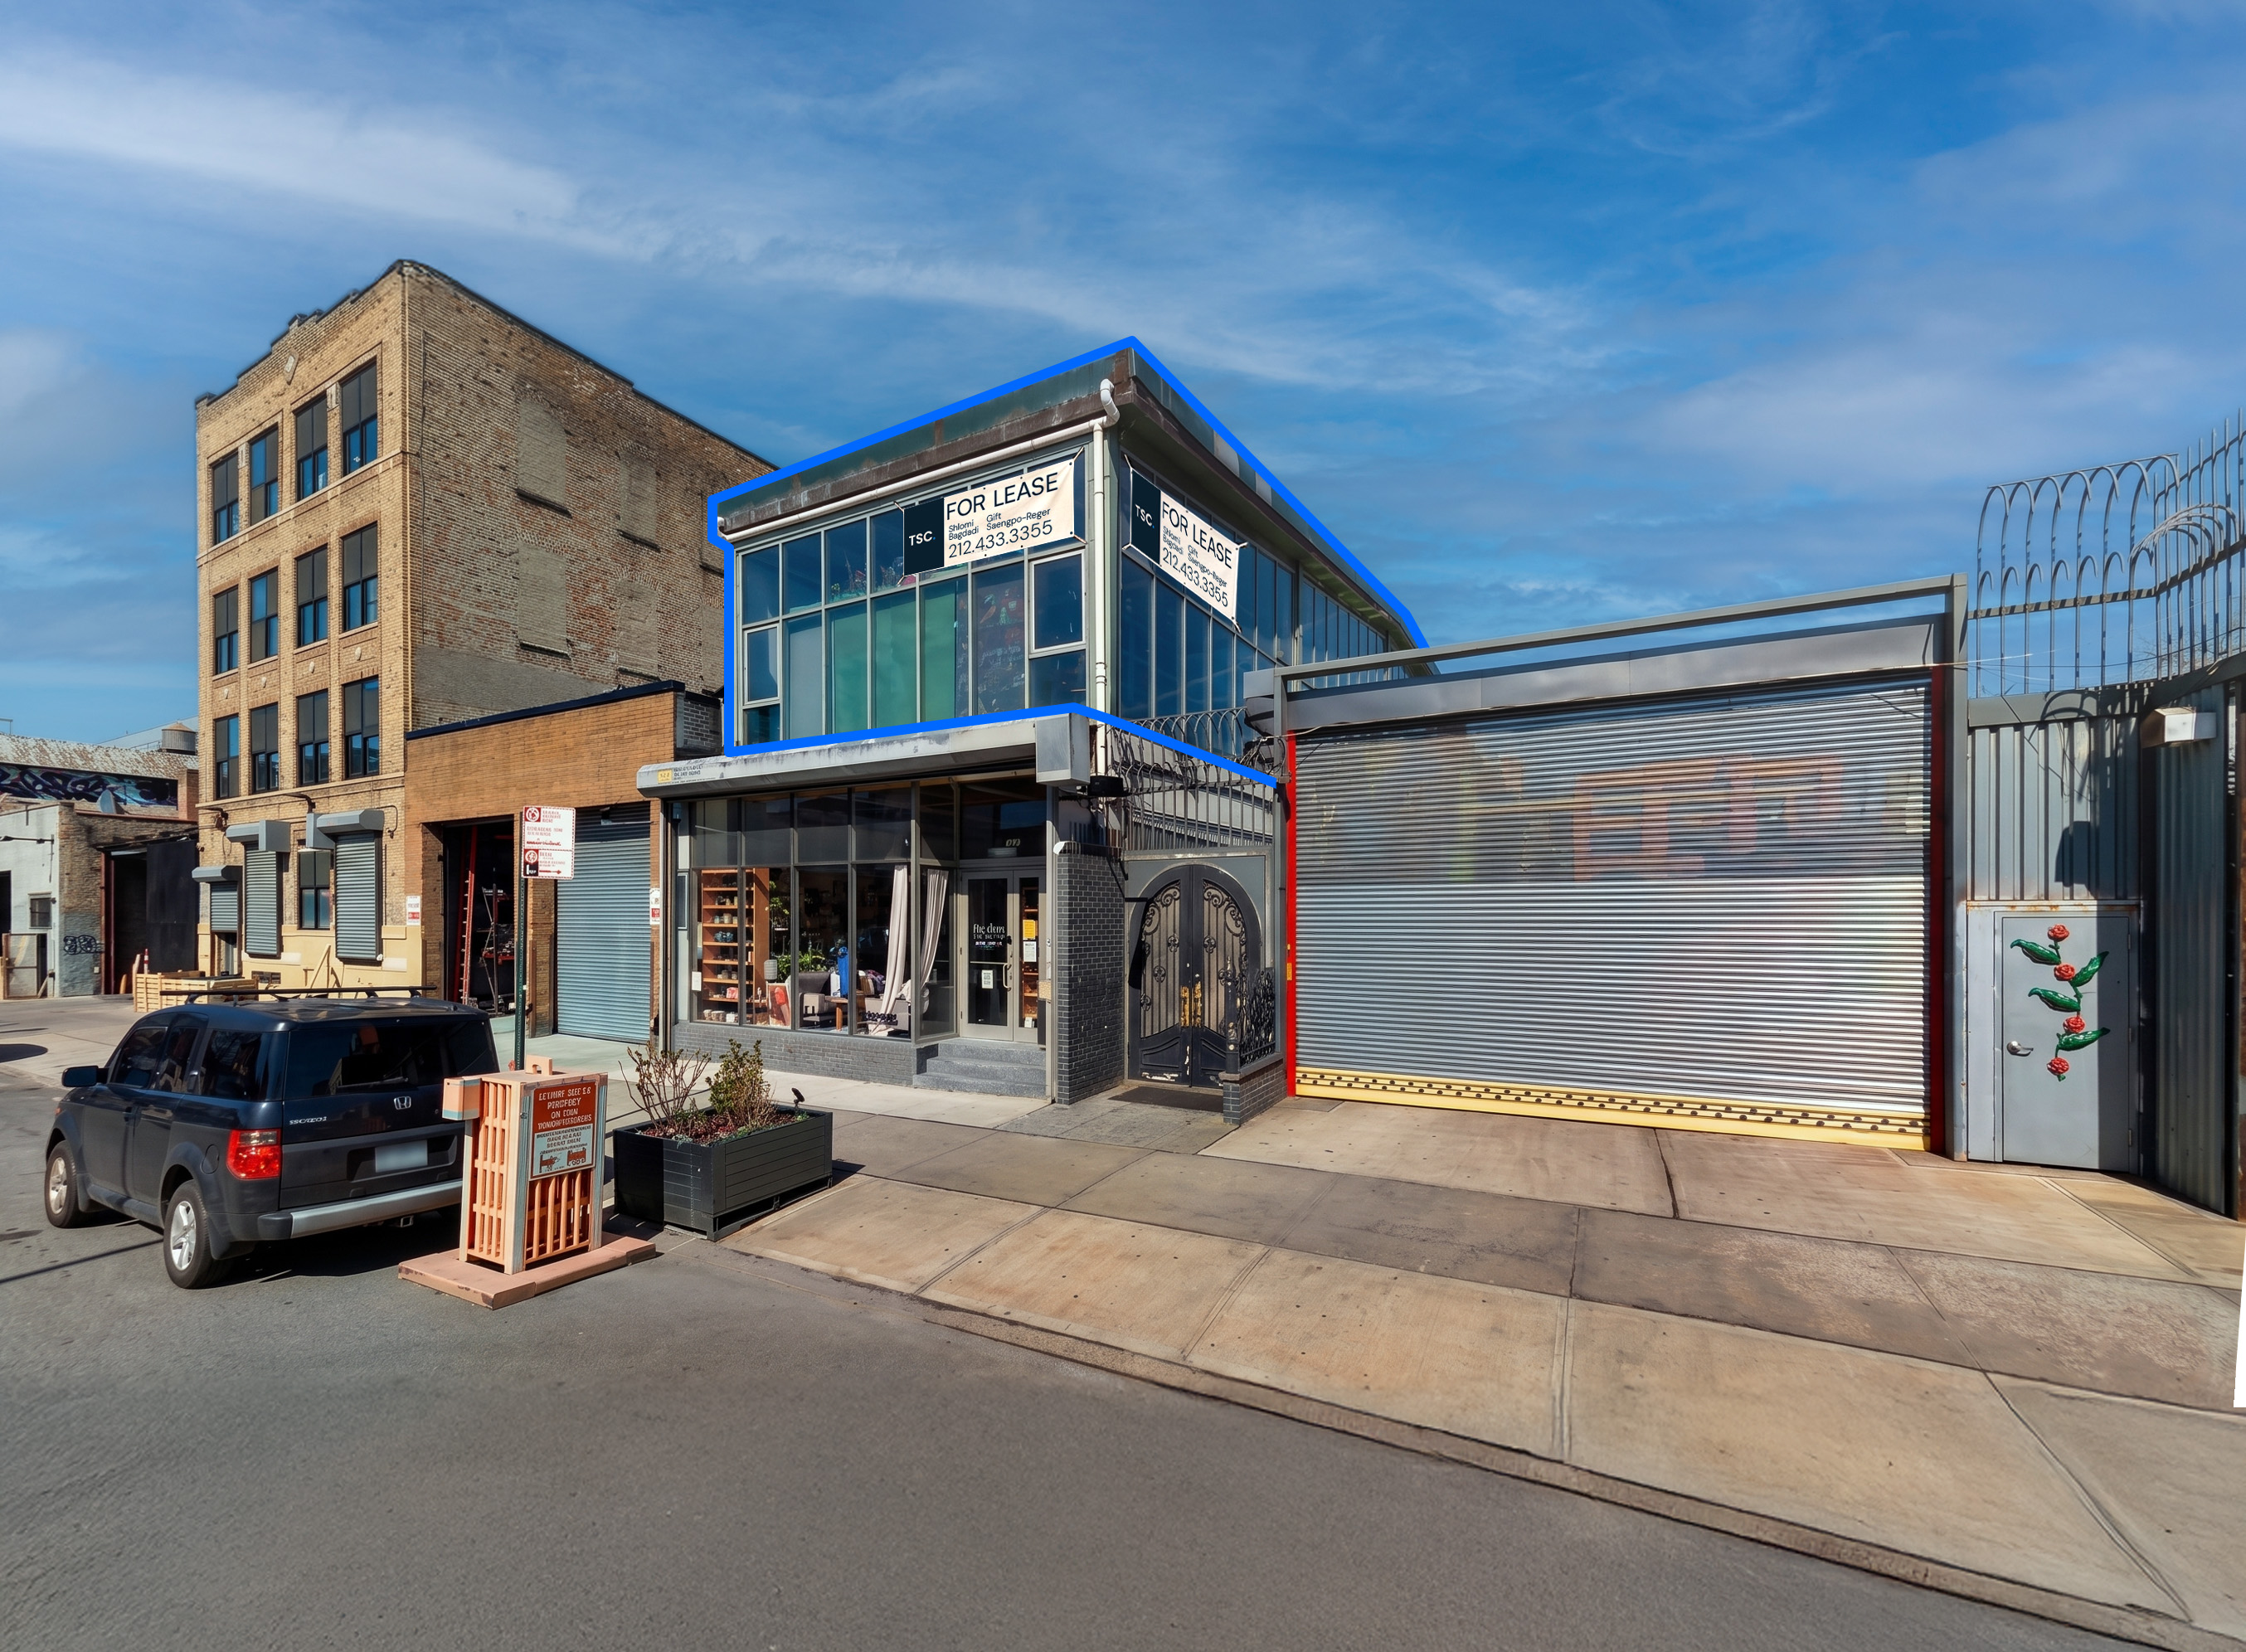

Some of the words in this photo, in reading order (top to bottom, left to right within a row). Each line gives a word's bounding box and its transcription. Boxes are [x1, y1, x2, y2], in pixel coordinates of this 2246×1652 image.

[946, 494, 985, 520] FOR
[994, 472, 1058, 508] LEASE
[948, 519, 975, 532] Shlomi
[986, 513, 1002, 522] Gift
[986, 508, 1051, 531] Saengpo-Reger
[948, 526, 980, 541] Bagdadi
[948, 519, 1053, 559] 212.433.3355
[1162, 501, 1189, 537] FOR
[1193, 523, 1232, 570] LEASE
[1163, 547, 1228, 607] 212.433.3355
